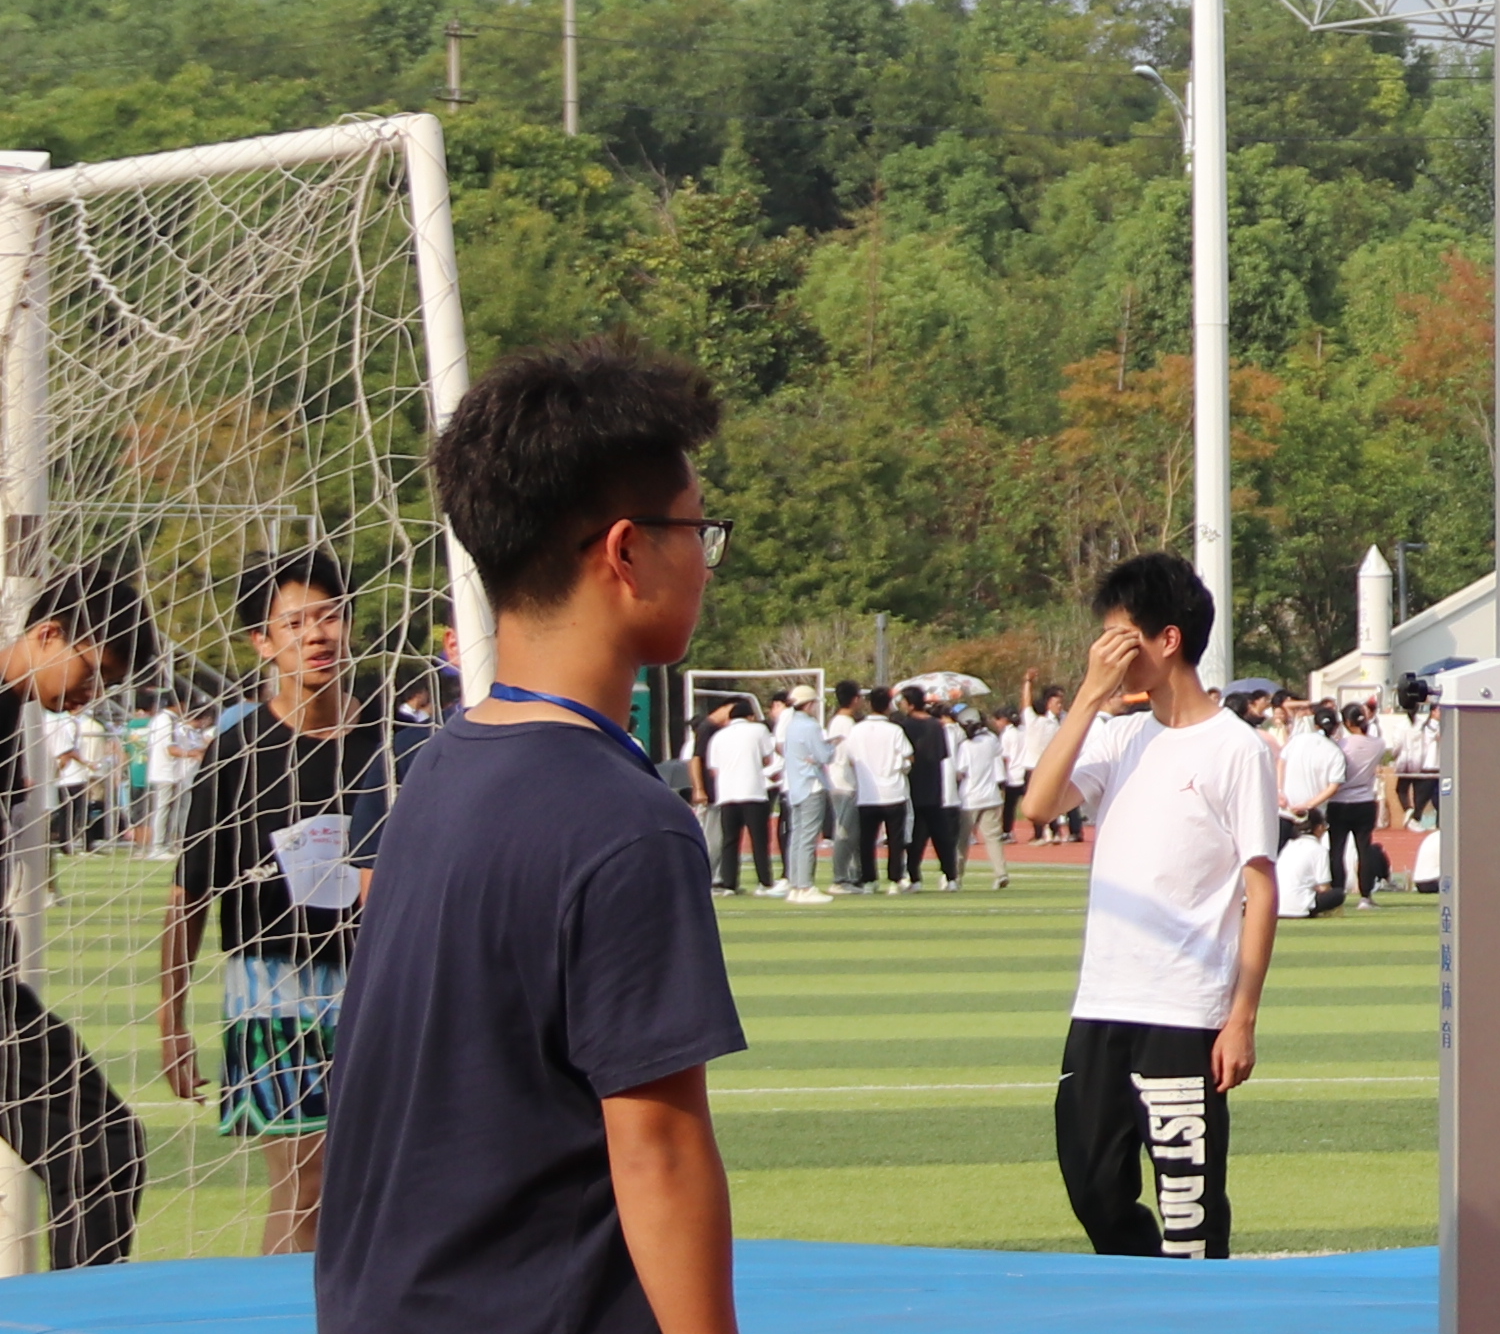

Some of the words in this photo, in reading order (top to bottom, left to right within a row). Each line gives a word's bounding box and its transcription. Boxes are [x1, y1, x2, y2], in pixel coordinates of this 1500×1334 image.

[1441, 906, 1452, 1049] 金陵体育
[1130, 1072, 1207, 1165] JUST
[1160, 1173, 1206, 1230] DO
